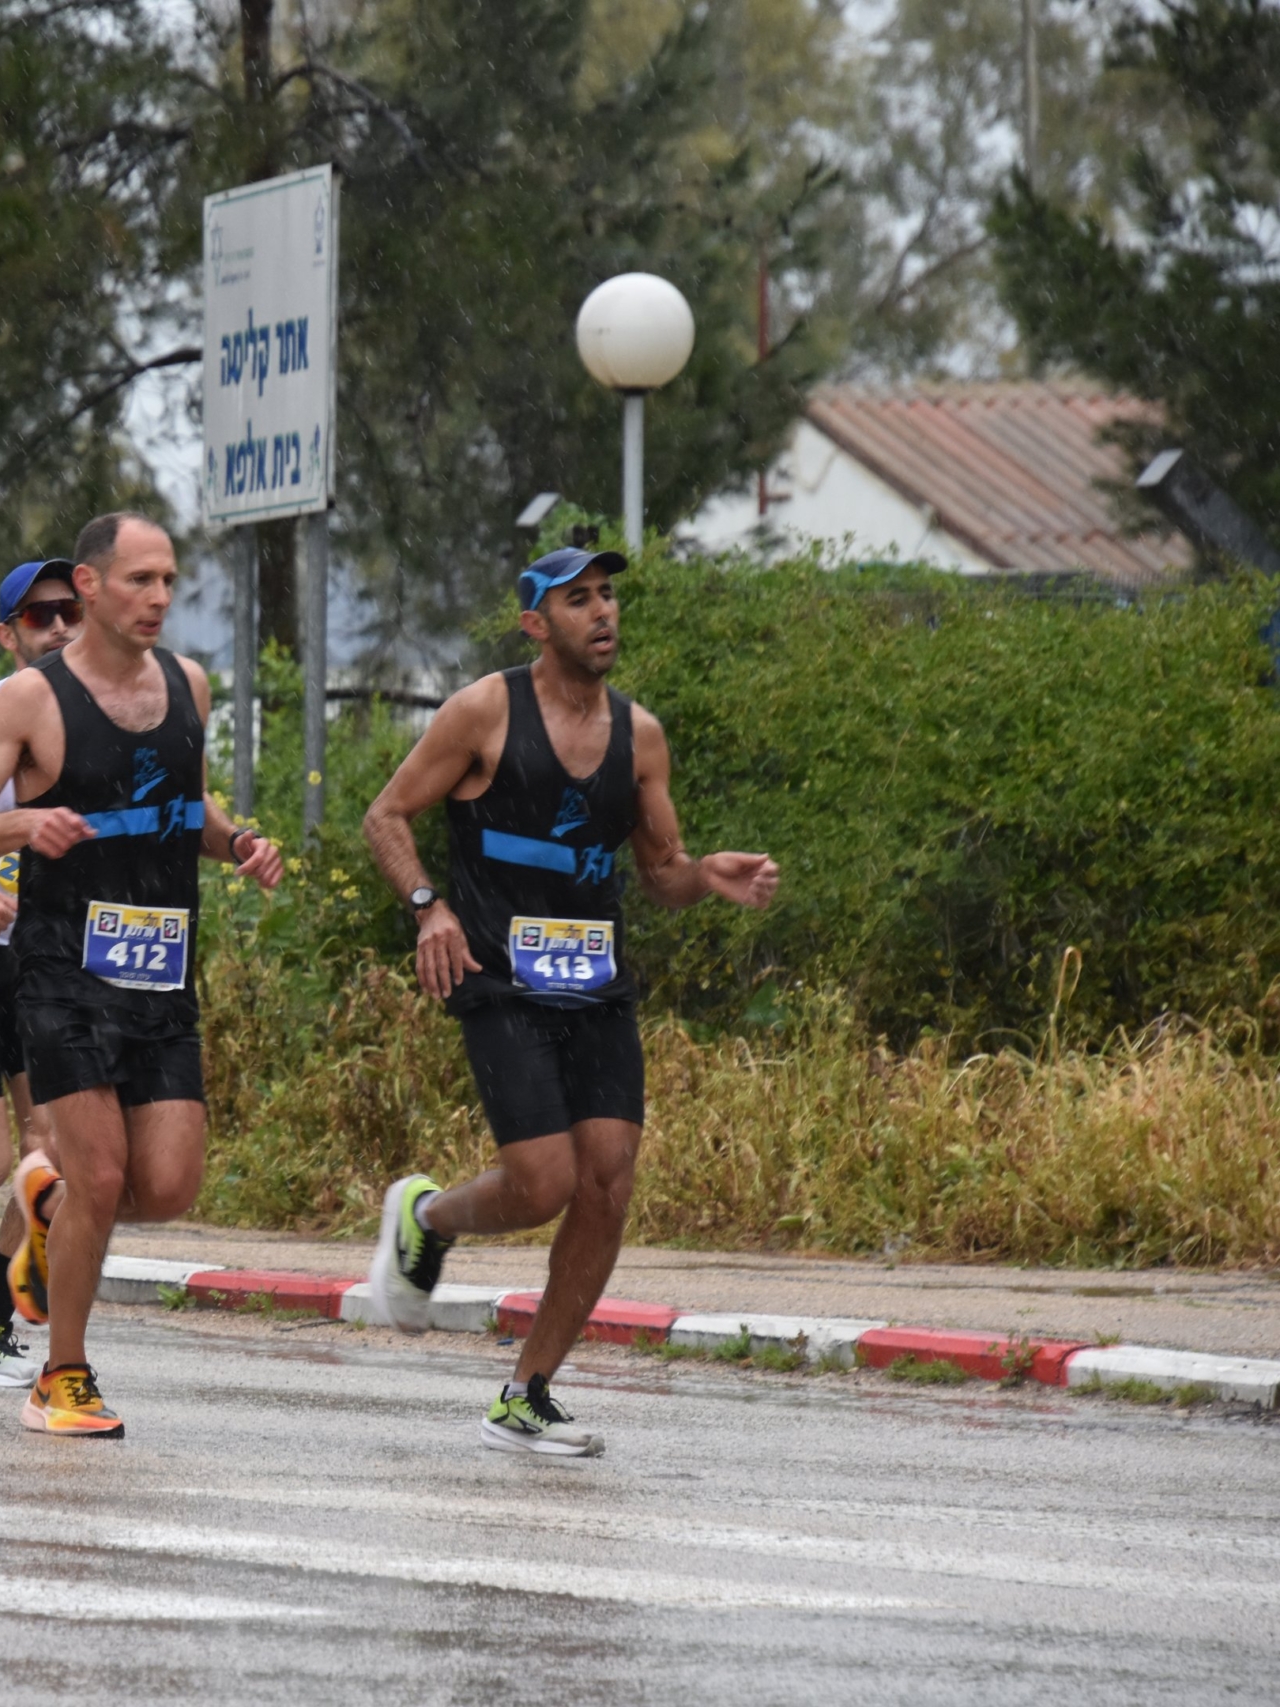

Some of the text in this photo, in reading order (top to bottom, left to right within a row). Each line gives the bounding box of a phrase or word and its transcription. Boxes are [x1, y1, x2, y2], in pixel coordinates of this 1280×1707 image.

[220, 307, 308, 398] אתר קליטה
[225, 418, 301, 497] בית אלפא
[106, 941, 168, 970] 412
[534, 954, 595, 980] 413
